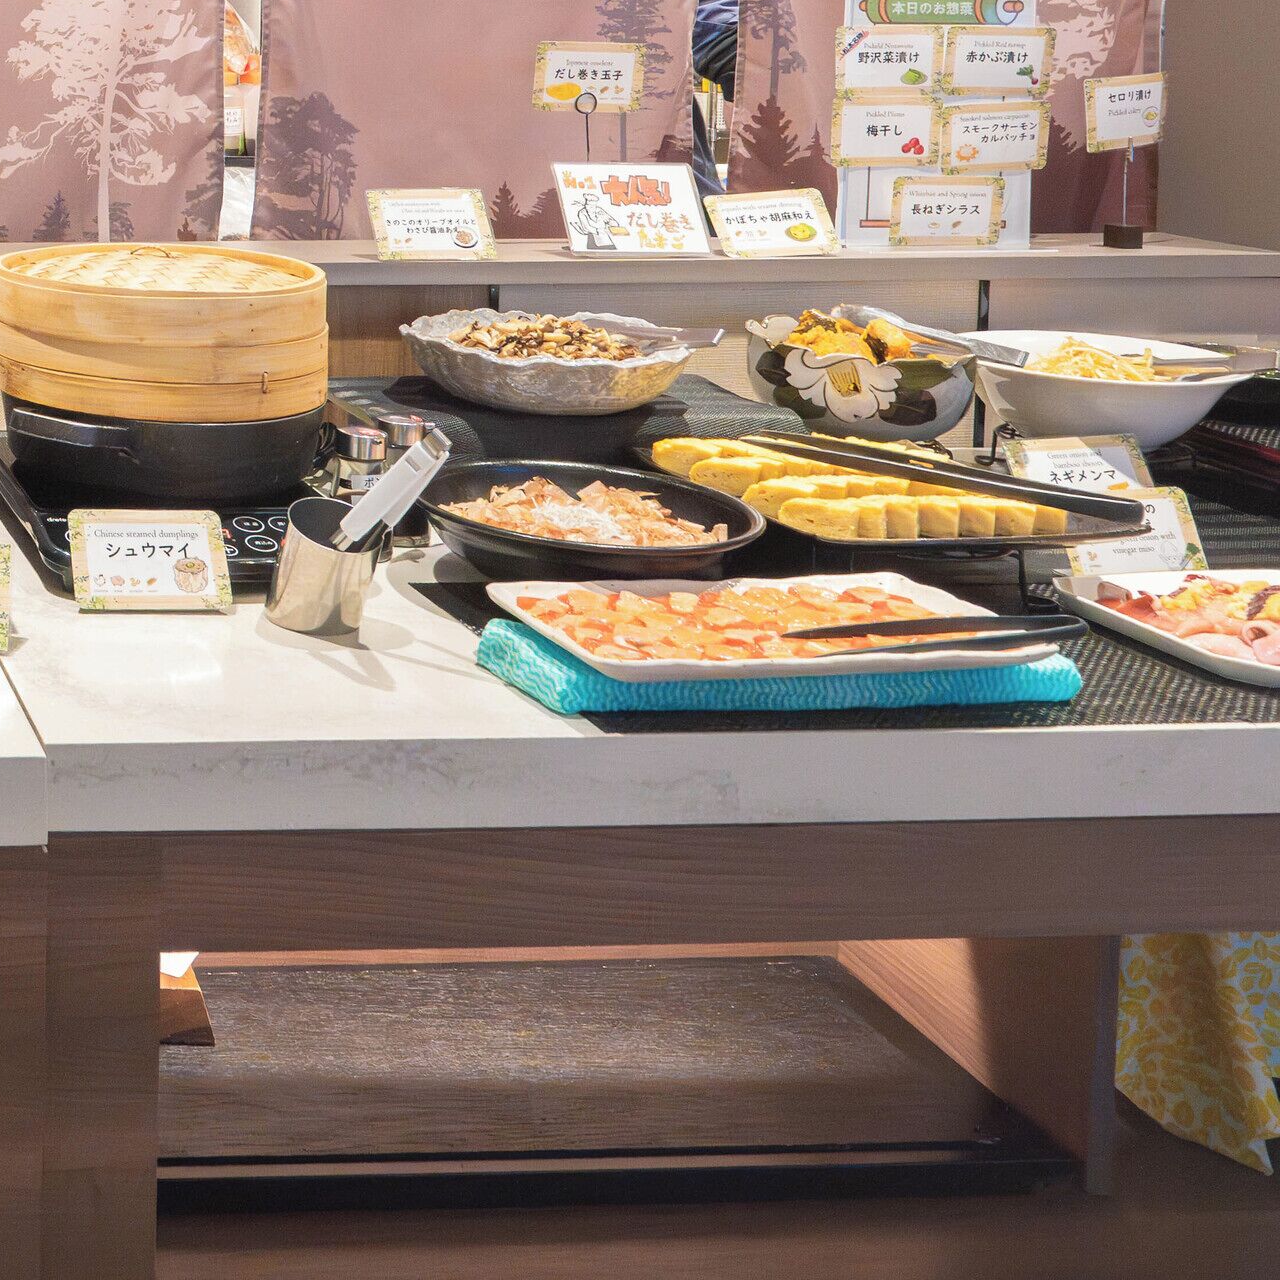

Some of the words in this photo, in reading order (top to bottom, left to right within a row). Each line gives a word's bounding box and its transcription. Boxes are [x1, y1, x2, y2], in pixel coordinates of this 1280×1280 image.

[891, 1, 974, 16] 本日のお惣菜
[858, 51, 920, 64] 野沢菜漬け
[966, 50, 1028, 63] 赤かぶ漬け
[555, 68, 623, 80] だし巻き玉子
[1108, 89, 1151, 103] セロリ漬け
[866, 124, 902, 136] 梅干し
[962, 122, 1037, 134] スモークサーモン
[911, 203, 980, 215] 長ねぎシラス
[725, 210, 814, 225] かぼちゃ胡麻和え
[1050, 469, 1116, 484] ネギメンマ
[94, 529, 124, 538] Chinese
[126, 529, 157, 538] steamed
[159, 529, 199, 541] dumplings
[105, 542, 190, 558] シュウマイ
